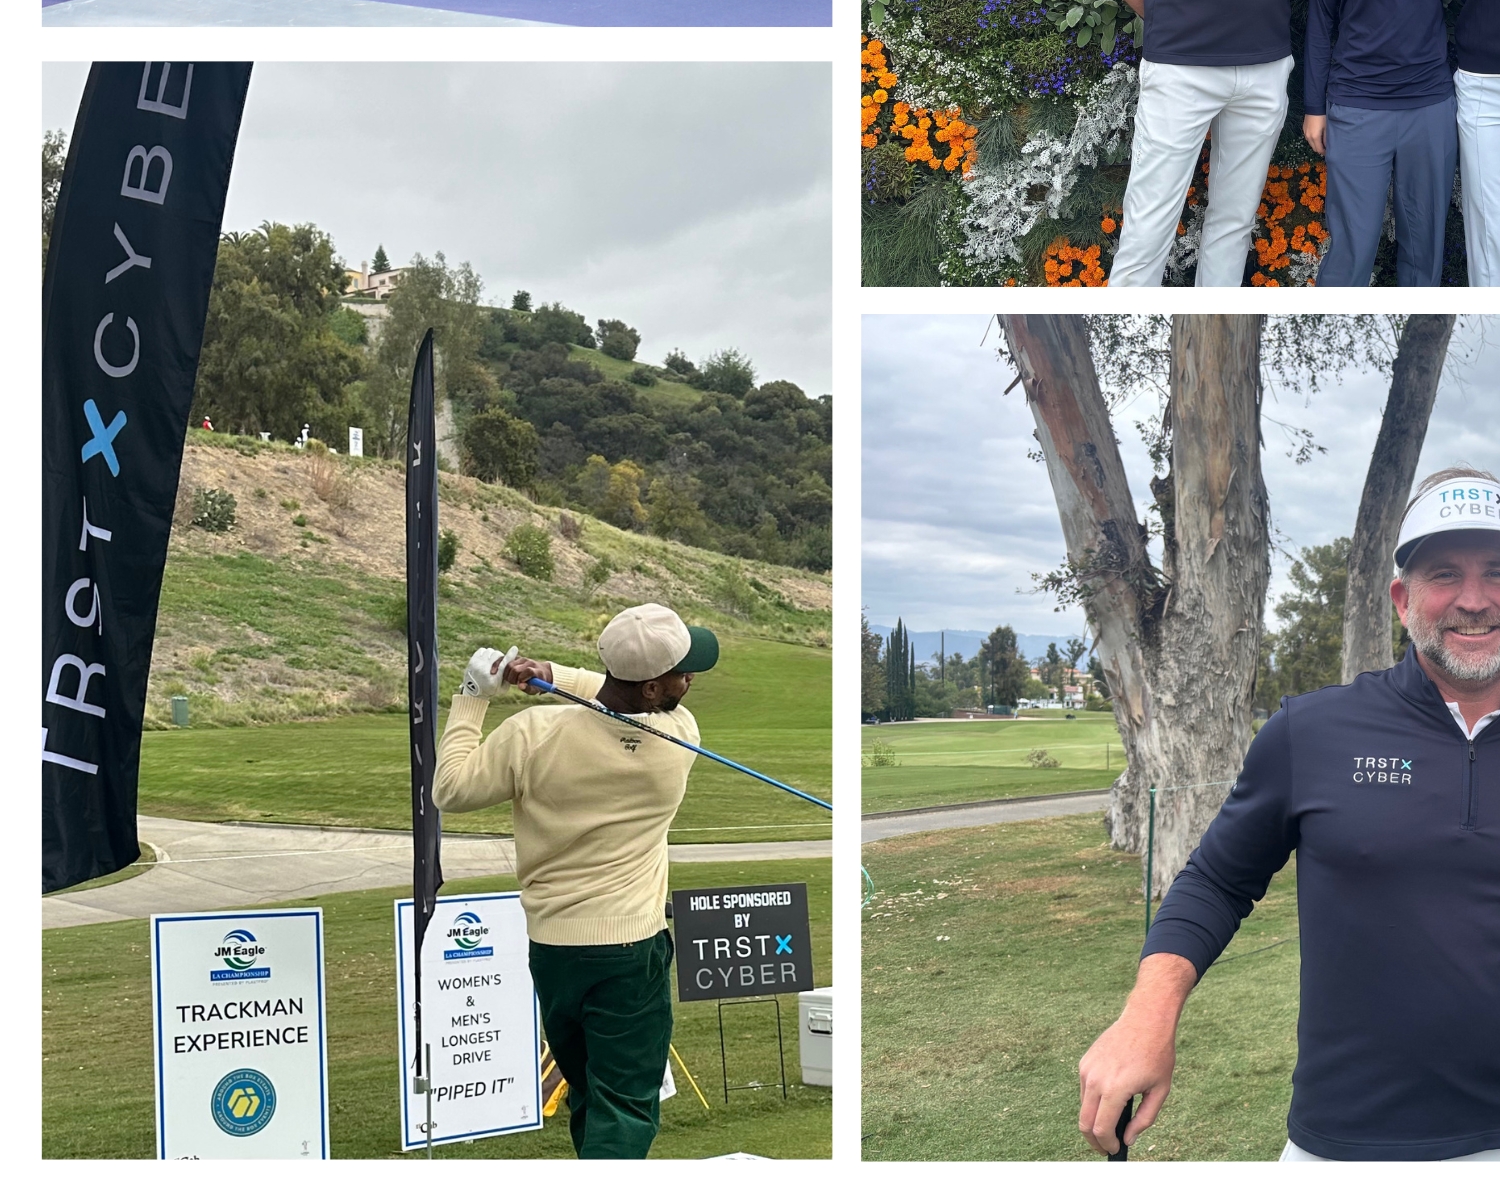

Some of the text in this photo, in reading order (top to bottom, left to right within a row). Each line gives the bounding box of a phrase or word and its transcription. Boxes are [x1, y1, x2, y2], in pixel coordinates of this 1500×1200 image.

[1352, 772, 1412, 785] CYBER
[690, 890, 792, 911] HOLE SPONSORED
[734, 913, 750, 928] BY
[446, 926, 489, 938] JM Eagle
[214, 945, 266, 956] JM Eagle
[221, 970, 269, 978] CHAMPIONSHIP
[696, 962, 797, 990] CYBER
[437, 974, 502, 991] WOMEN'S
[466, 996, 476, 1007] &
[176, 998, 304, 1024] TRACKMAN
[451, 1012, 491, 1028] MEN'S
[174, 1026, 309, 1054] EXPERIENCE
[442, 1030, 502, 1048] LONGEST
[453, 1050, 492, 1066] DRIVE
